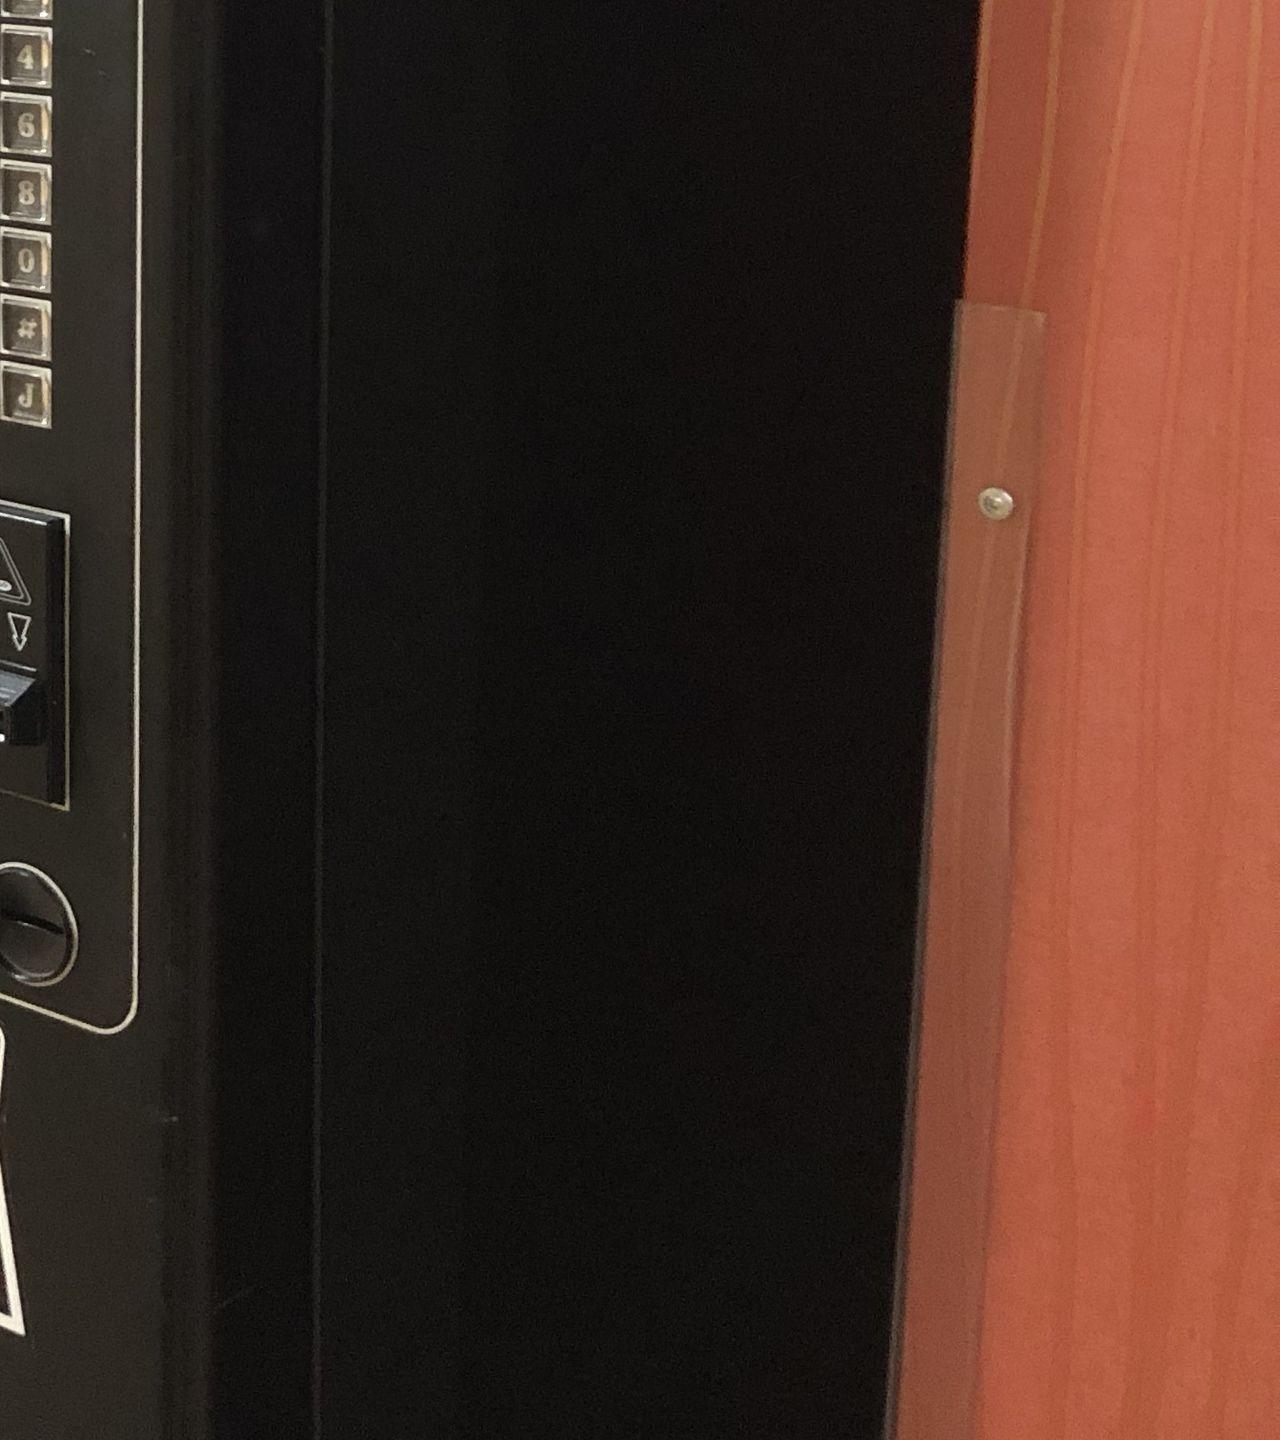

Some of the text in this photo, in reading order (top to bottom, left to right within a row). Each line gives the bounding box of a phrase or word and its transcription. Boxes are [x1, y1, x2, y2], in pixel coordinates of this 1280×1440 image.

[17, 45, 34, 70] 4
[17, 112, 35, 138] 6
[18, 180, 35, 205] 8
[18, 383, 34, 408] J
